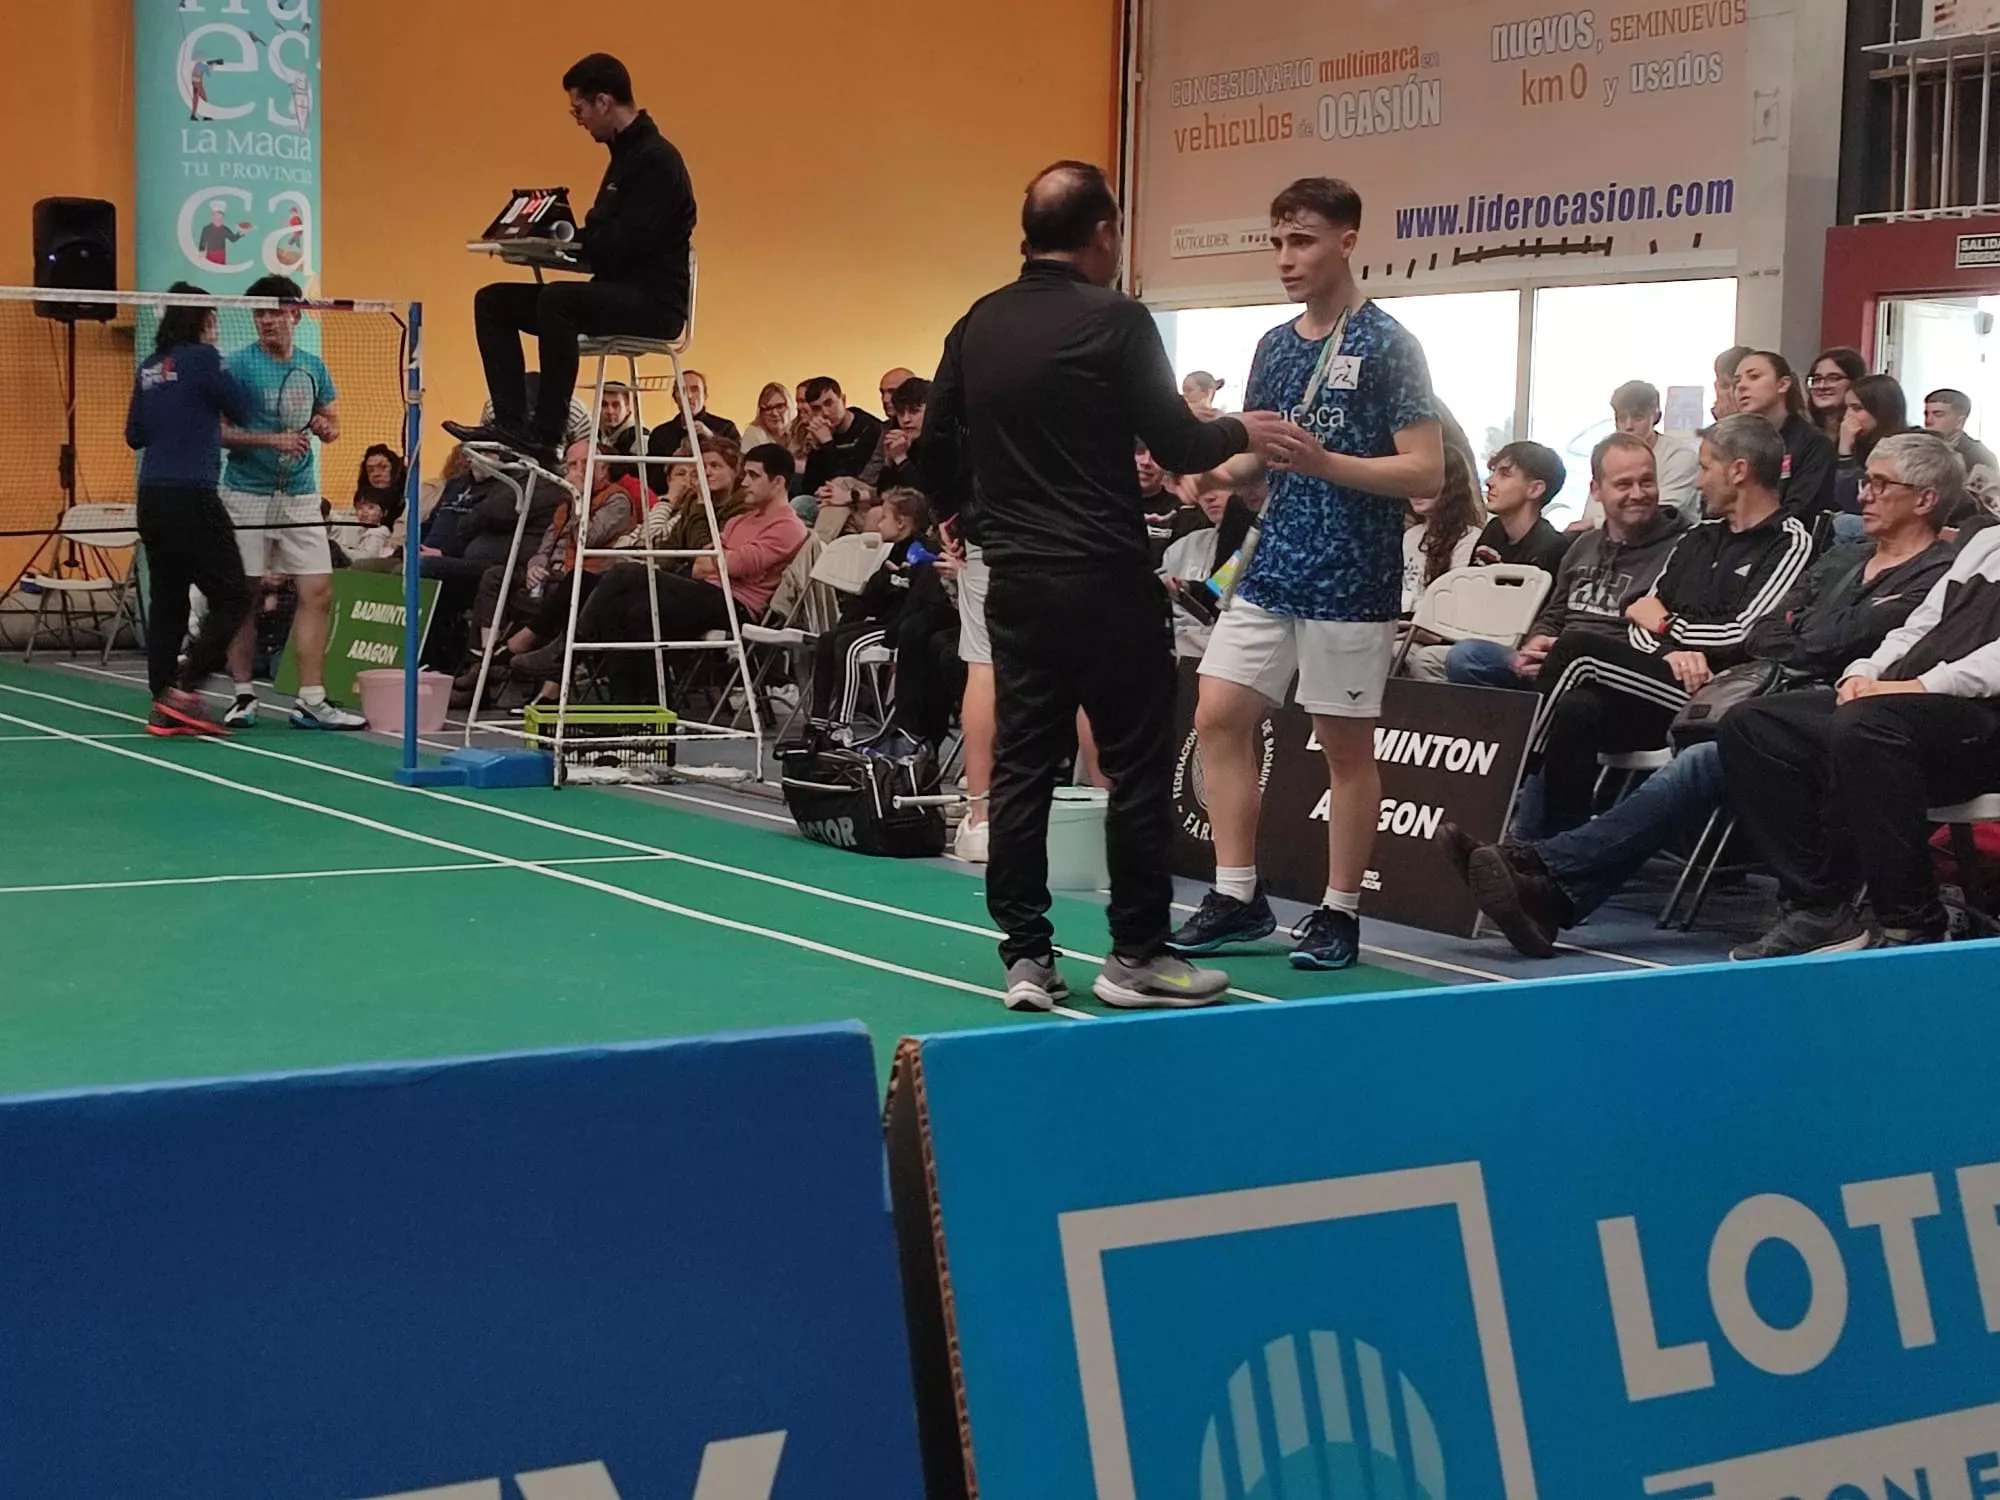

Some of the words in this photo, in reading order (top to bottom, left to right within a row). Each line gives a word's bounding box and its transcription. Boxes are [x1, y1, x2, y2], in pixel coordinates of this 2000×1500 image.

[1609, 0, 1747, 43] SEMINUEVOS
[1170, 57, 1314, 108] CONCESIONARIO
[1319, 45, 1420, 84] multimarca
[1603, 77, 1618, 107] y
[1630, 51, 1723, 93] usados
[1317, 73, 1442, 141] OCASIÓN
[1396, 178, 1735, 239] www.liderocasion.com
[350, 600, 422, 627] BADMINT
[346, 640, 398, 666] ARAGON
[1258, 737, 1275, 796] BADMINT
[1305, 727, 1500, 776] MINTON
[1308, 788, 1444, 840] AGON
